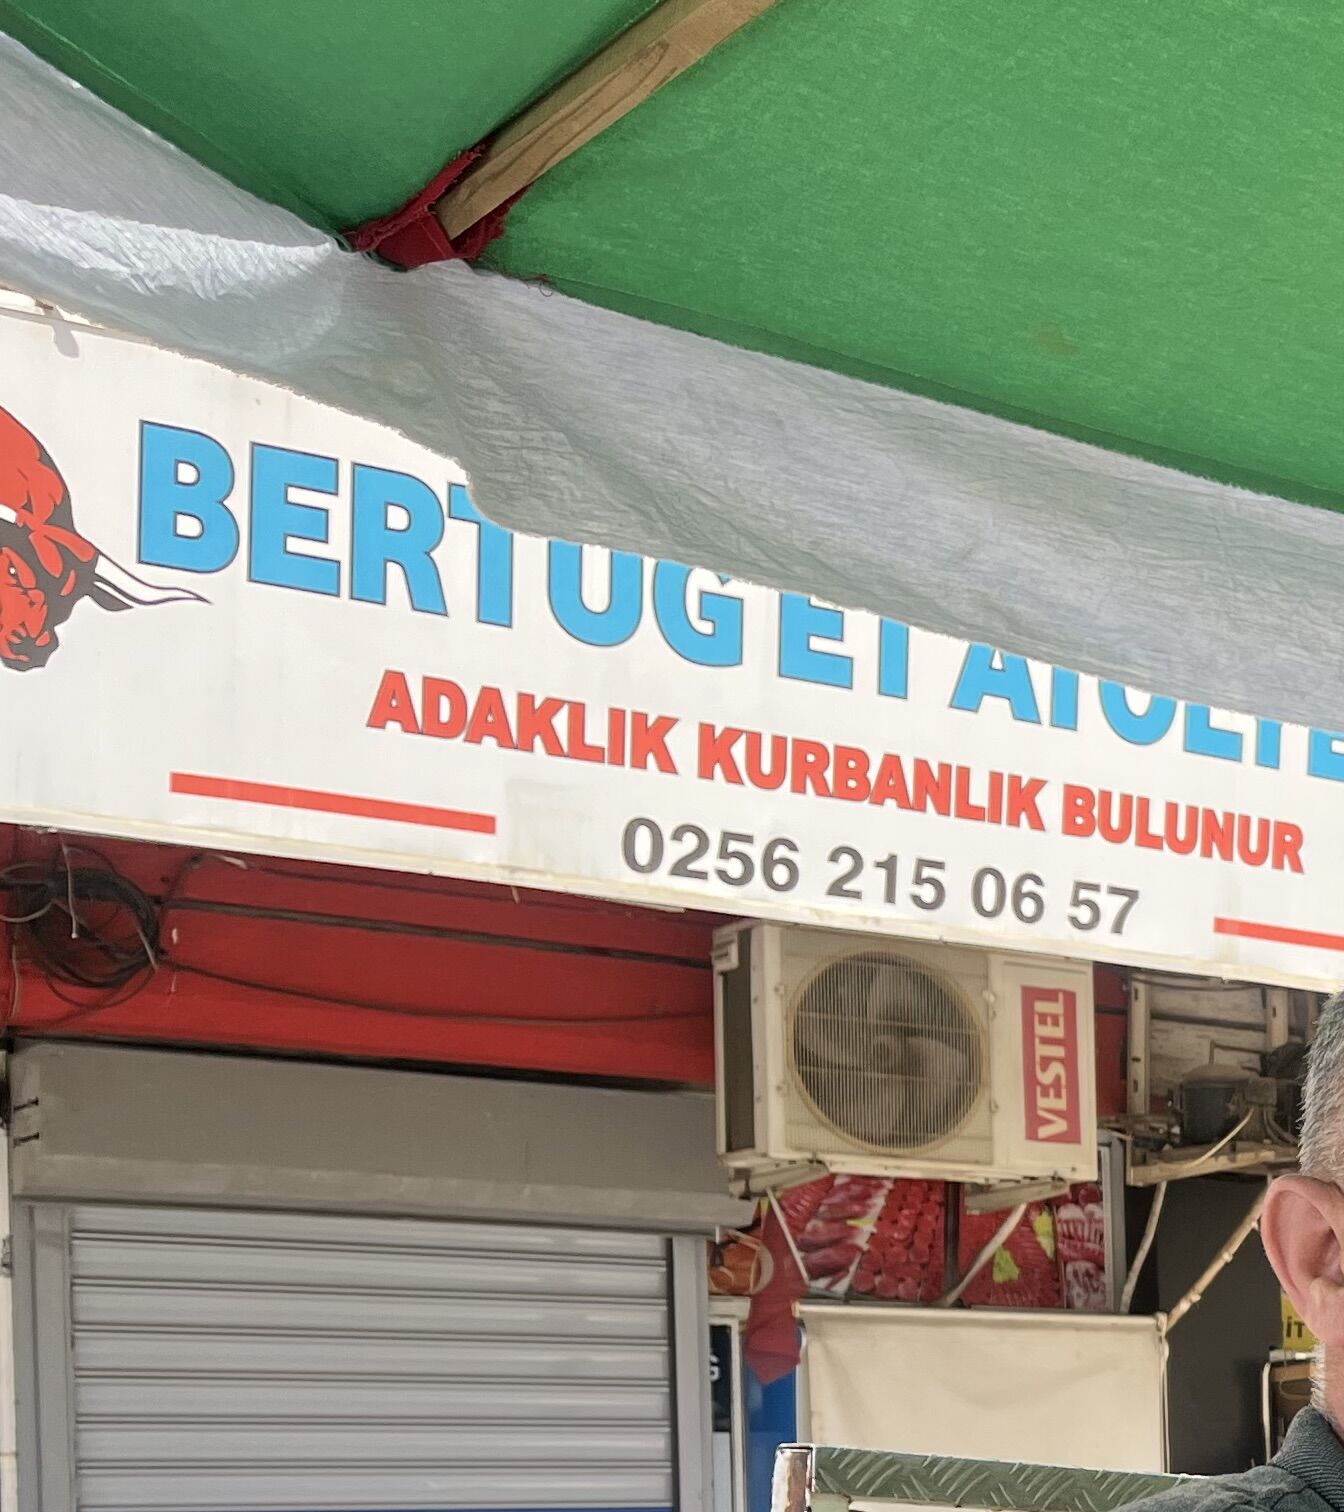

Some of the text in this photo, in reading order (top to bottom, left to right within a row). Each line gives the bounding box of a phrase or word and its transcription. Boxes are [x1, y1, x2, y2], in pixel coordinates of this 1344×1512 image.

[778, 591, 911, 701] ET
[366, 669, 1305, 874] ADAKLIK KURBANLIK BULUNUR
[622, 816, 1141, 936] 0256 215 06 57
[1034, 991, 1069, 1140] VESTEL
